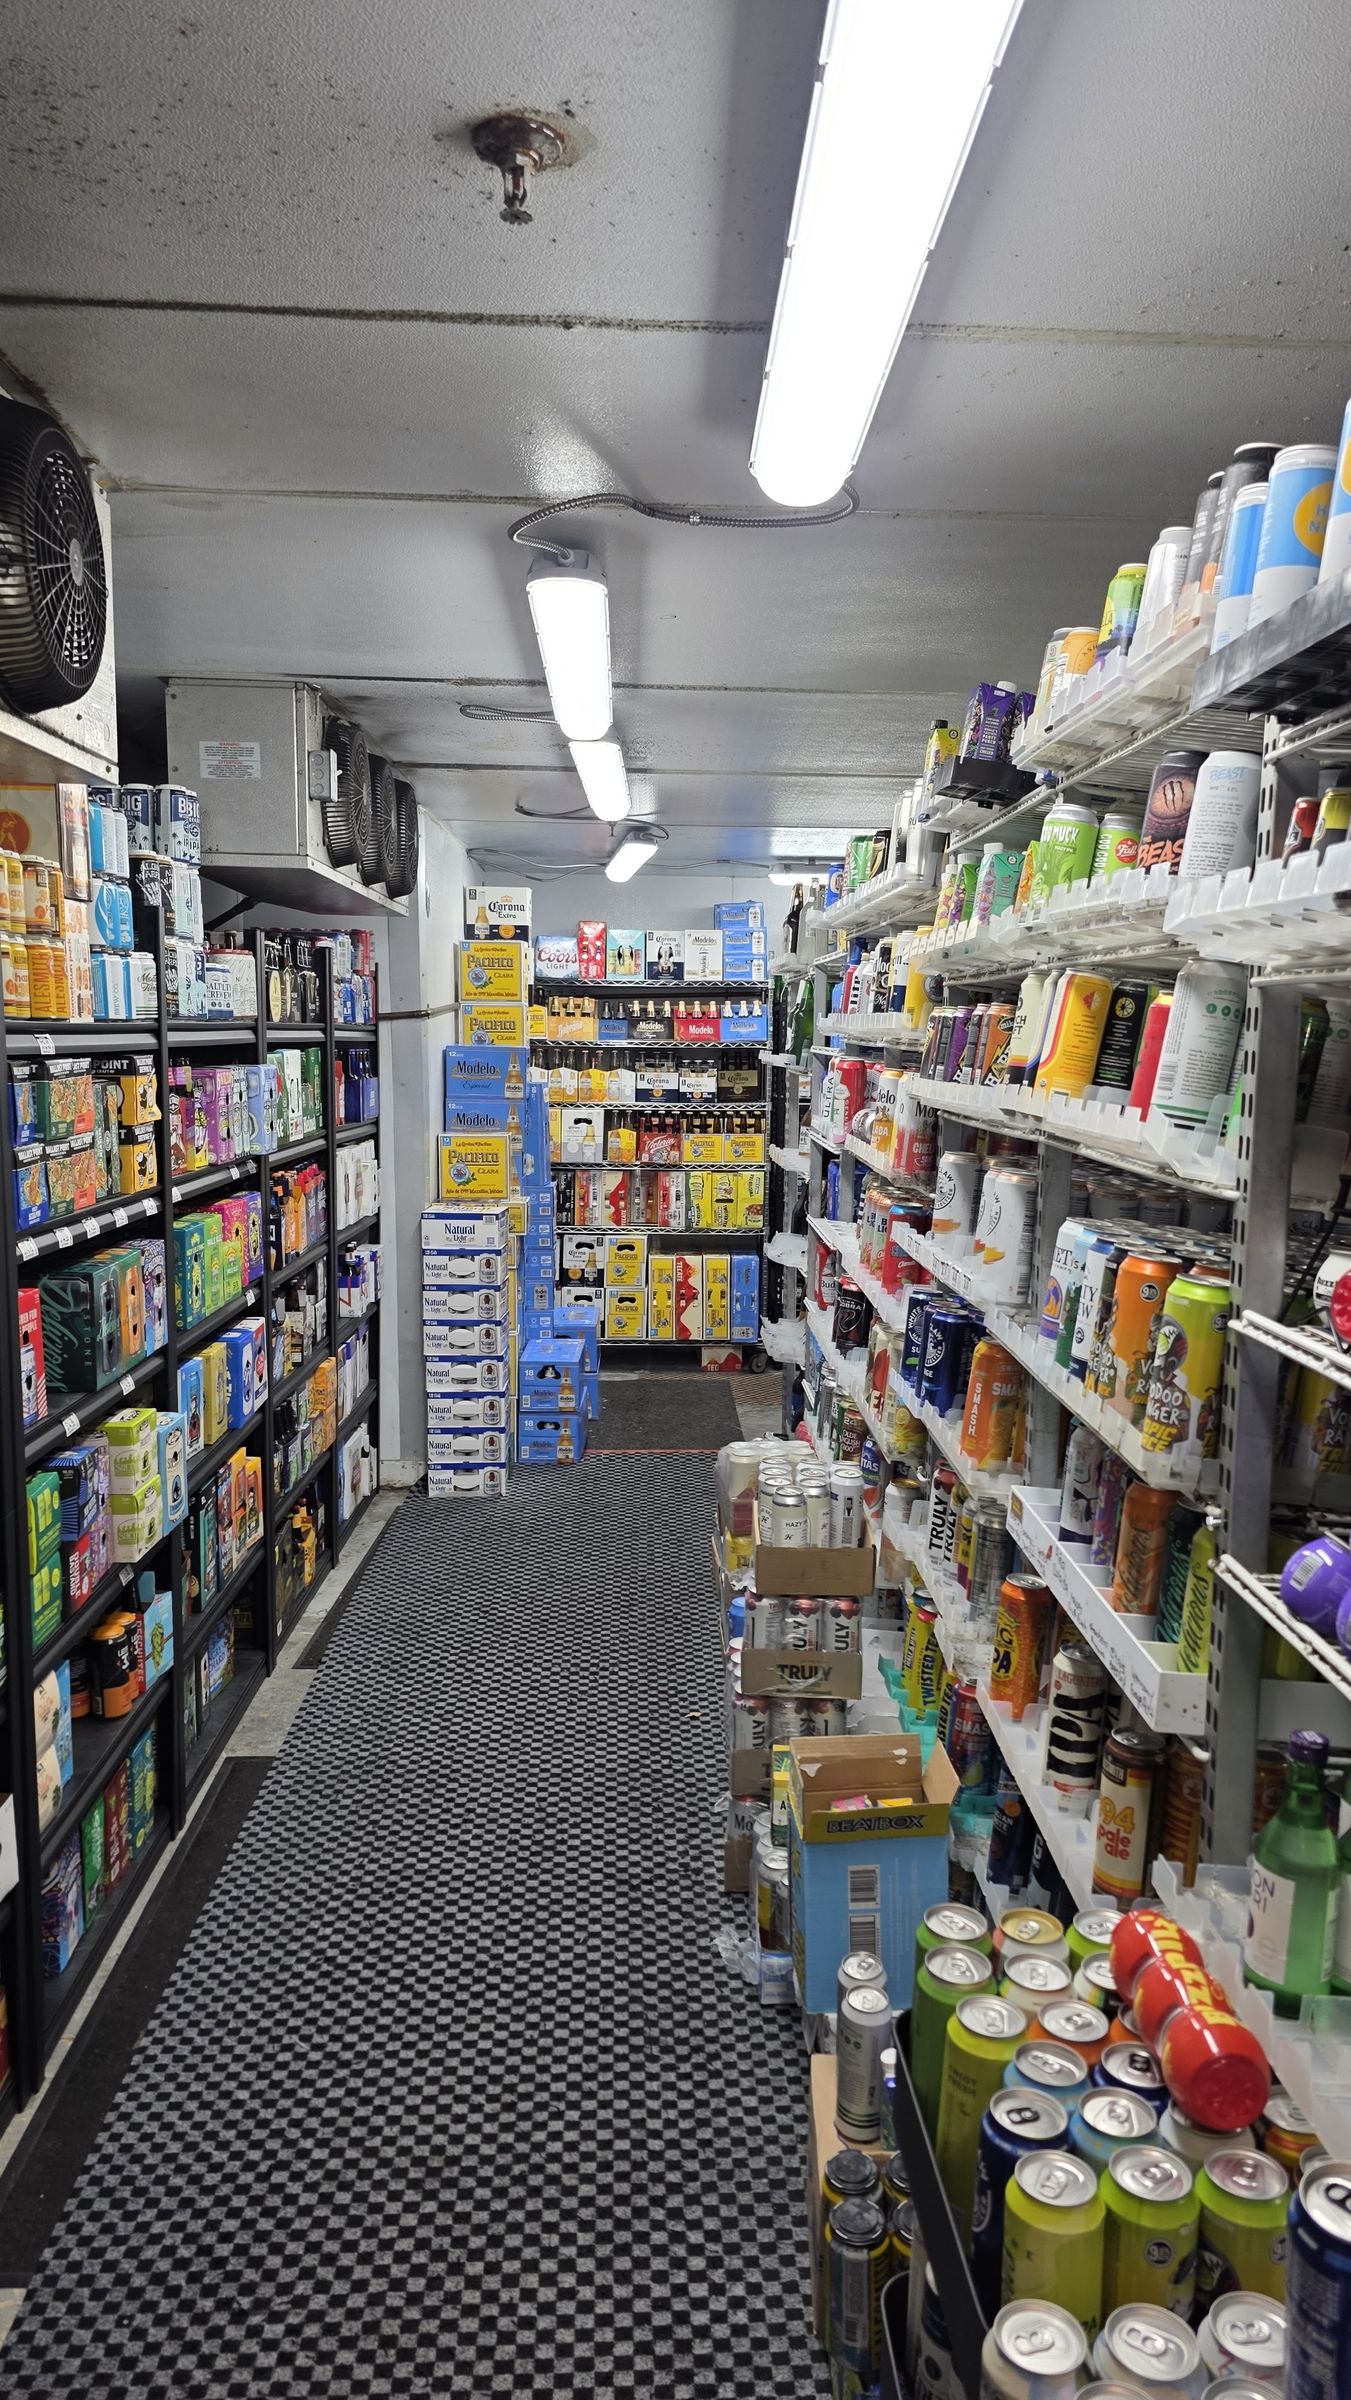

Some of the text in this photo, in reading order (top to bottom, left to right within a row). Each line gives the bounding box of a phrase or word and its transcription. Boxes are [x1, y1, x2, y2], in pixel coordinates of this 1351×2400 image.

[1053, 825, 1080, 844] MUCK
[488, 901, 526, 913] Corona
[498, 911, 516, 919] Extra
[467, 954, 514, 969] PACIFICO
[537, 947, 578, 963] Coors
[32, 953, 51, 1013] ALESMITH
[470, 1017, 517, 1032] PACIFICO
[639, 1022, 663, 1030] Modelo
[688, 1024, 714, 1035] Modelo
[93, 1060, 129, 1072] POINT
[457, 1061, 496, 1075] Modelo
[823, 1077, 835, 1118] ULTRA
[456, 1113, 495, 1126] Modelo
[645, 1135, 676, 1153] Victoria
[448, 1150, 500, 1164] PACIFICO
[444, 1224, 476, 1235] Natural
[425, 1263, 448, 1271] Natural
[424, 1298, 448, 1306] Natural
[908, 1306, 921, 1329] WHITE
[83, 1314, 92, 1367] STONE
[425, 1333, 448, 1341] Natural
[427, 1369, 450, 1377] Natural
[991, 1382, 1019, 1397] SMA
[428, 1405, 452, 1413] Natural
[968, 1383, 983, 1437] SMASH
[1146, 1400, 1180, 1425] NGER
[428, 1441, 452, 1449] Natural
[861, 1458, 880, 1472] ITAS
[429, 1477, 452, 1485] Natural
[929, 1494, 948, 1550] TRULY
[943, 1509, 957, 1562] TRULY
[792, 1619, 808, 1650] ULY
[834, 1621, 850, 1652] ULY
[777, 1663, 832, 1681] TRULY
[921, 1653, 936, 1706] TWISTED
[955, 1718, 991, 1735] SMAS
[827, 1814, 927, 1833] BEATBOX
[1104, 1840, 1130, 1861] ale
[1253, 1869, 1276, 1898] ON
